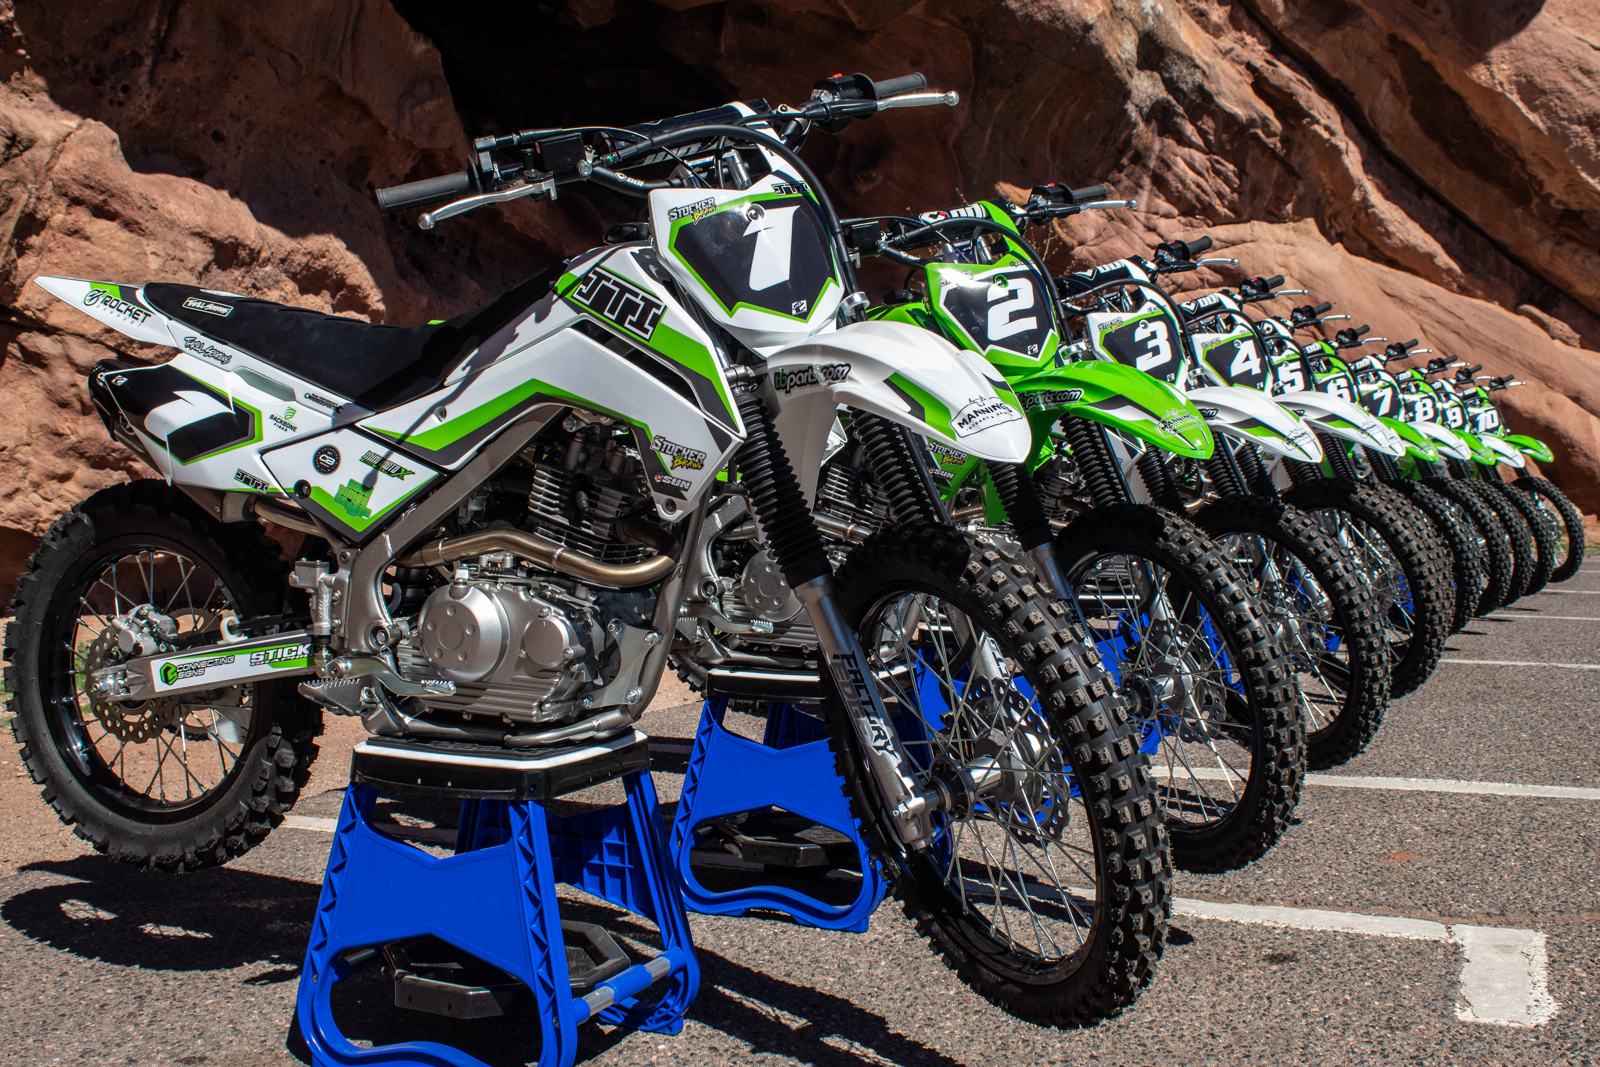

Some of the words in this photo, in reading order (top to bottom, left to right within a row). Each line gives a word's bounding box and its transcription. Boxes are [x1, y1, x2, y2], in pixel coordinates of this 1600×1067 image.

[668, 197, 716, 221] STOCKER
[743, 205, 800, 292] 1
[101, 295, 152, 323] ROCKET
[573, 266, 667, 341] JTI
[987, 278, 1038, 341] 2
[1134, 320, 1172, 372] 3
[1231, 340, 1262, 378] 4
[1278, 361, 1306, 394] 5
[1327, 378, 1351, 402] 6
[1373, 387, 1393, 416] 7
[1415, 398, 1434, 423] 8
[269, 414, 298, 432] BACKBONE
[1446, 406, 1463, 429] 9
[1477, 409, 1499, 433] 10
[650, 435, 707, 463] STOCKER
[928, 442, 967, 460] STOCKER
[661, 475, 692, 491] SUN
[176, 656, 235, 672] CONNECTING
[250, 643, 312, 663] STICK
